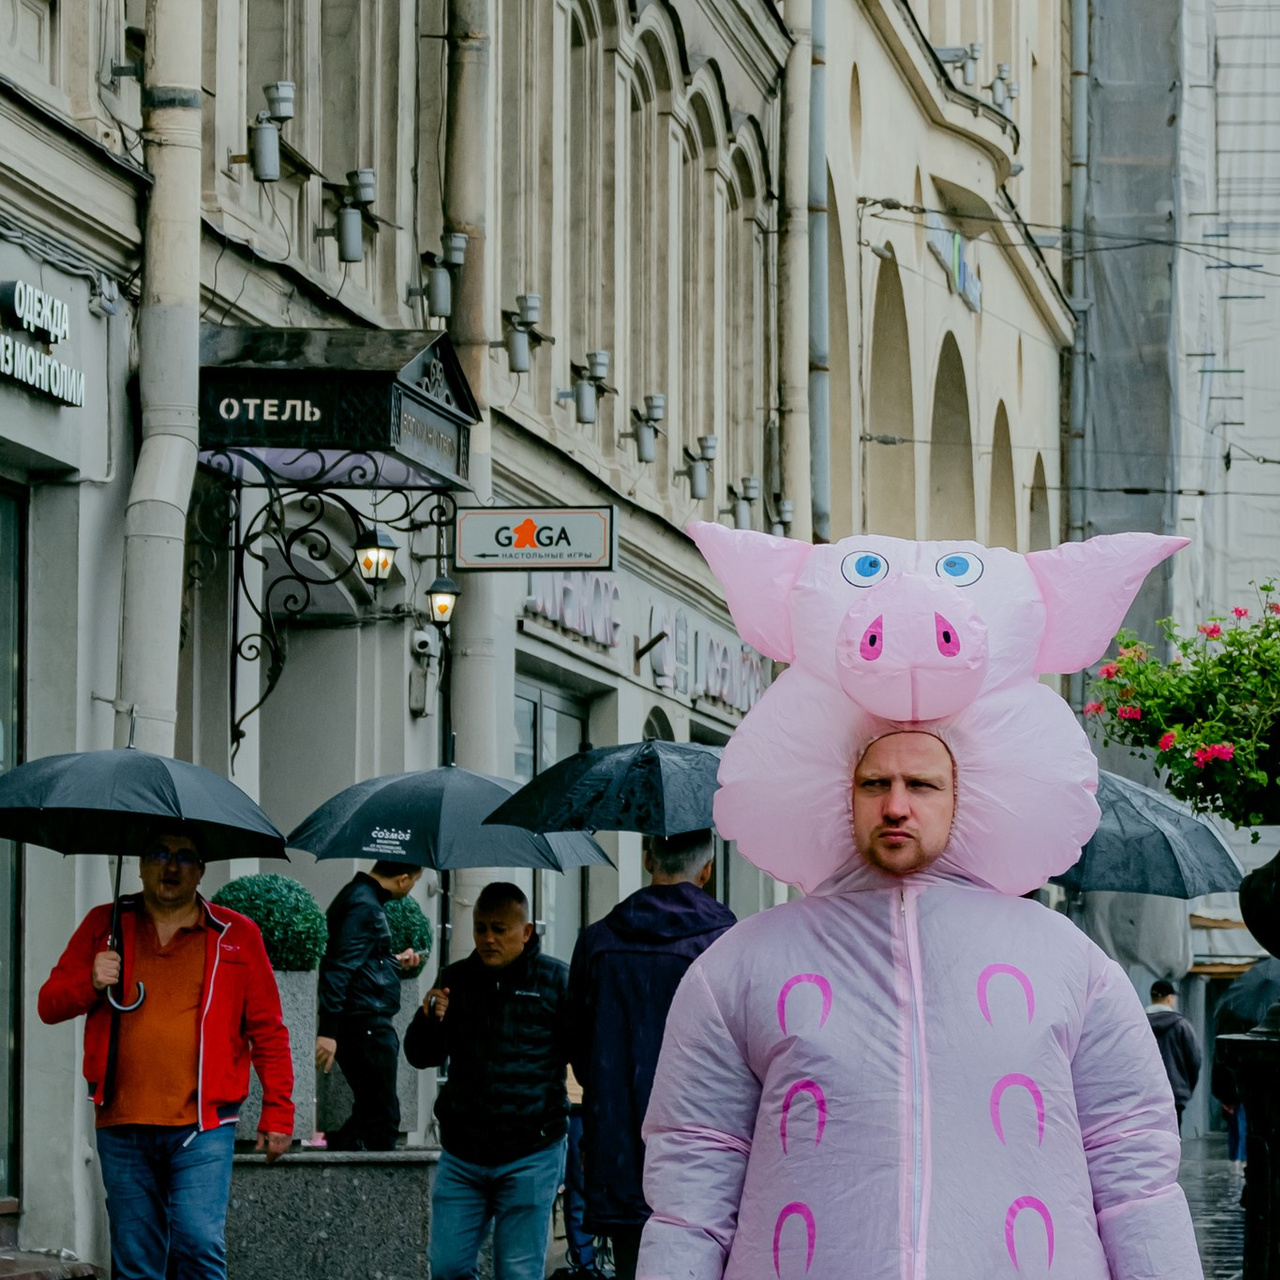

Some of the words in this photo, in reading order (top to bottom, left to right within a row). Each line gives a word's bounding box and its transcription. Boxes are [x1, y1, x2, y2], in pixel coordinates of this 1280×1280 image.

[14, 280, 70, 345] ОДЕЖДА
[14, 341, 85, 408] МОНГОЛИИ
[219, 398, 321, 421] ОТЕЛЬ
[371, 826, 411, 841] COSMOS
